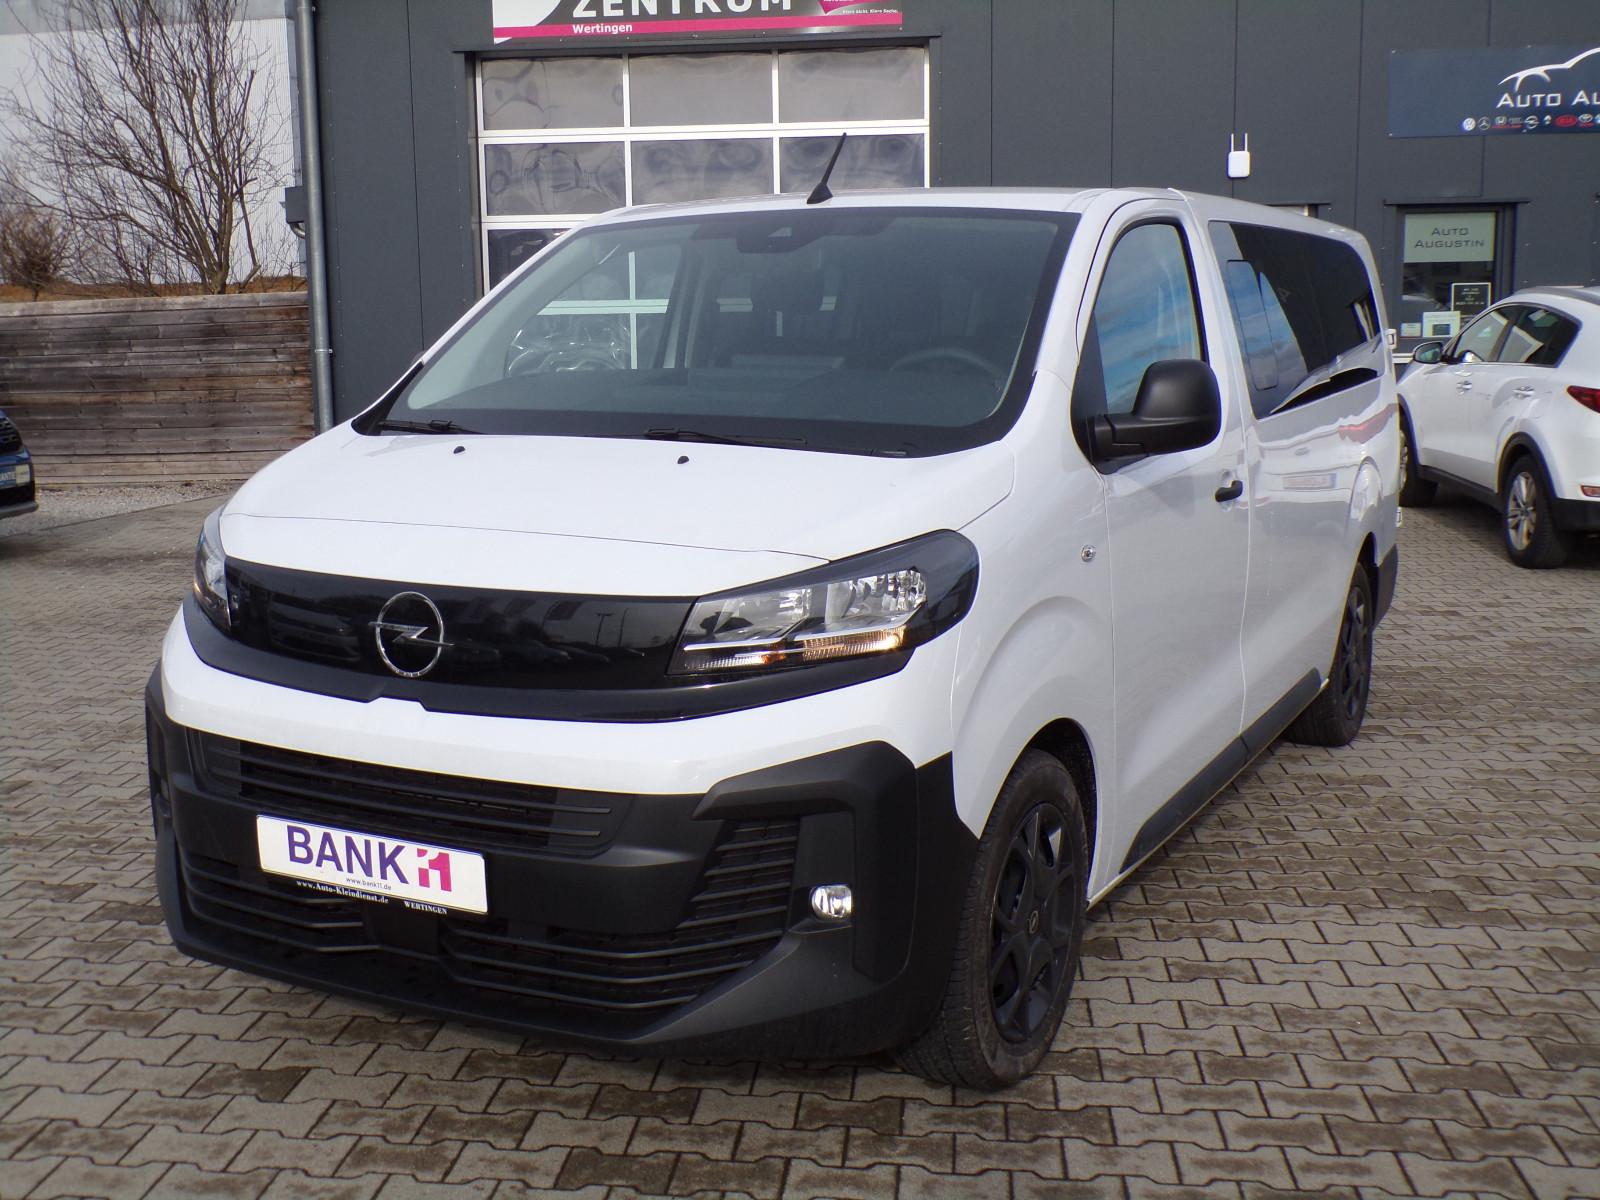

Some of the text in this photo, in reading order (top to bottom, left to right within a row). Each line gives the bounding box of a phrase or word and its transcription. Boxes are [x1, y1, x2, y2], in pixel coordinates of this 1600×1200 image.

[572, 23, 633, 35] Wertingen
[1496, 92, 1562, 109] AUTO
[1431, 227, 1470, 236] AUTO
[1413, 239, 1485, 249] AUGUSTIN
[346, 876, 392, 891] www.bank11.de
[296, 879, 448, 915] www.Auto-Kleindienst.de WERTINGEN
